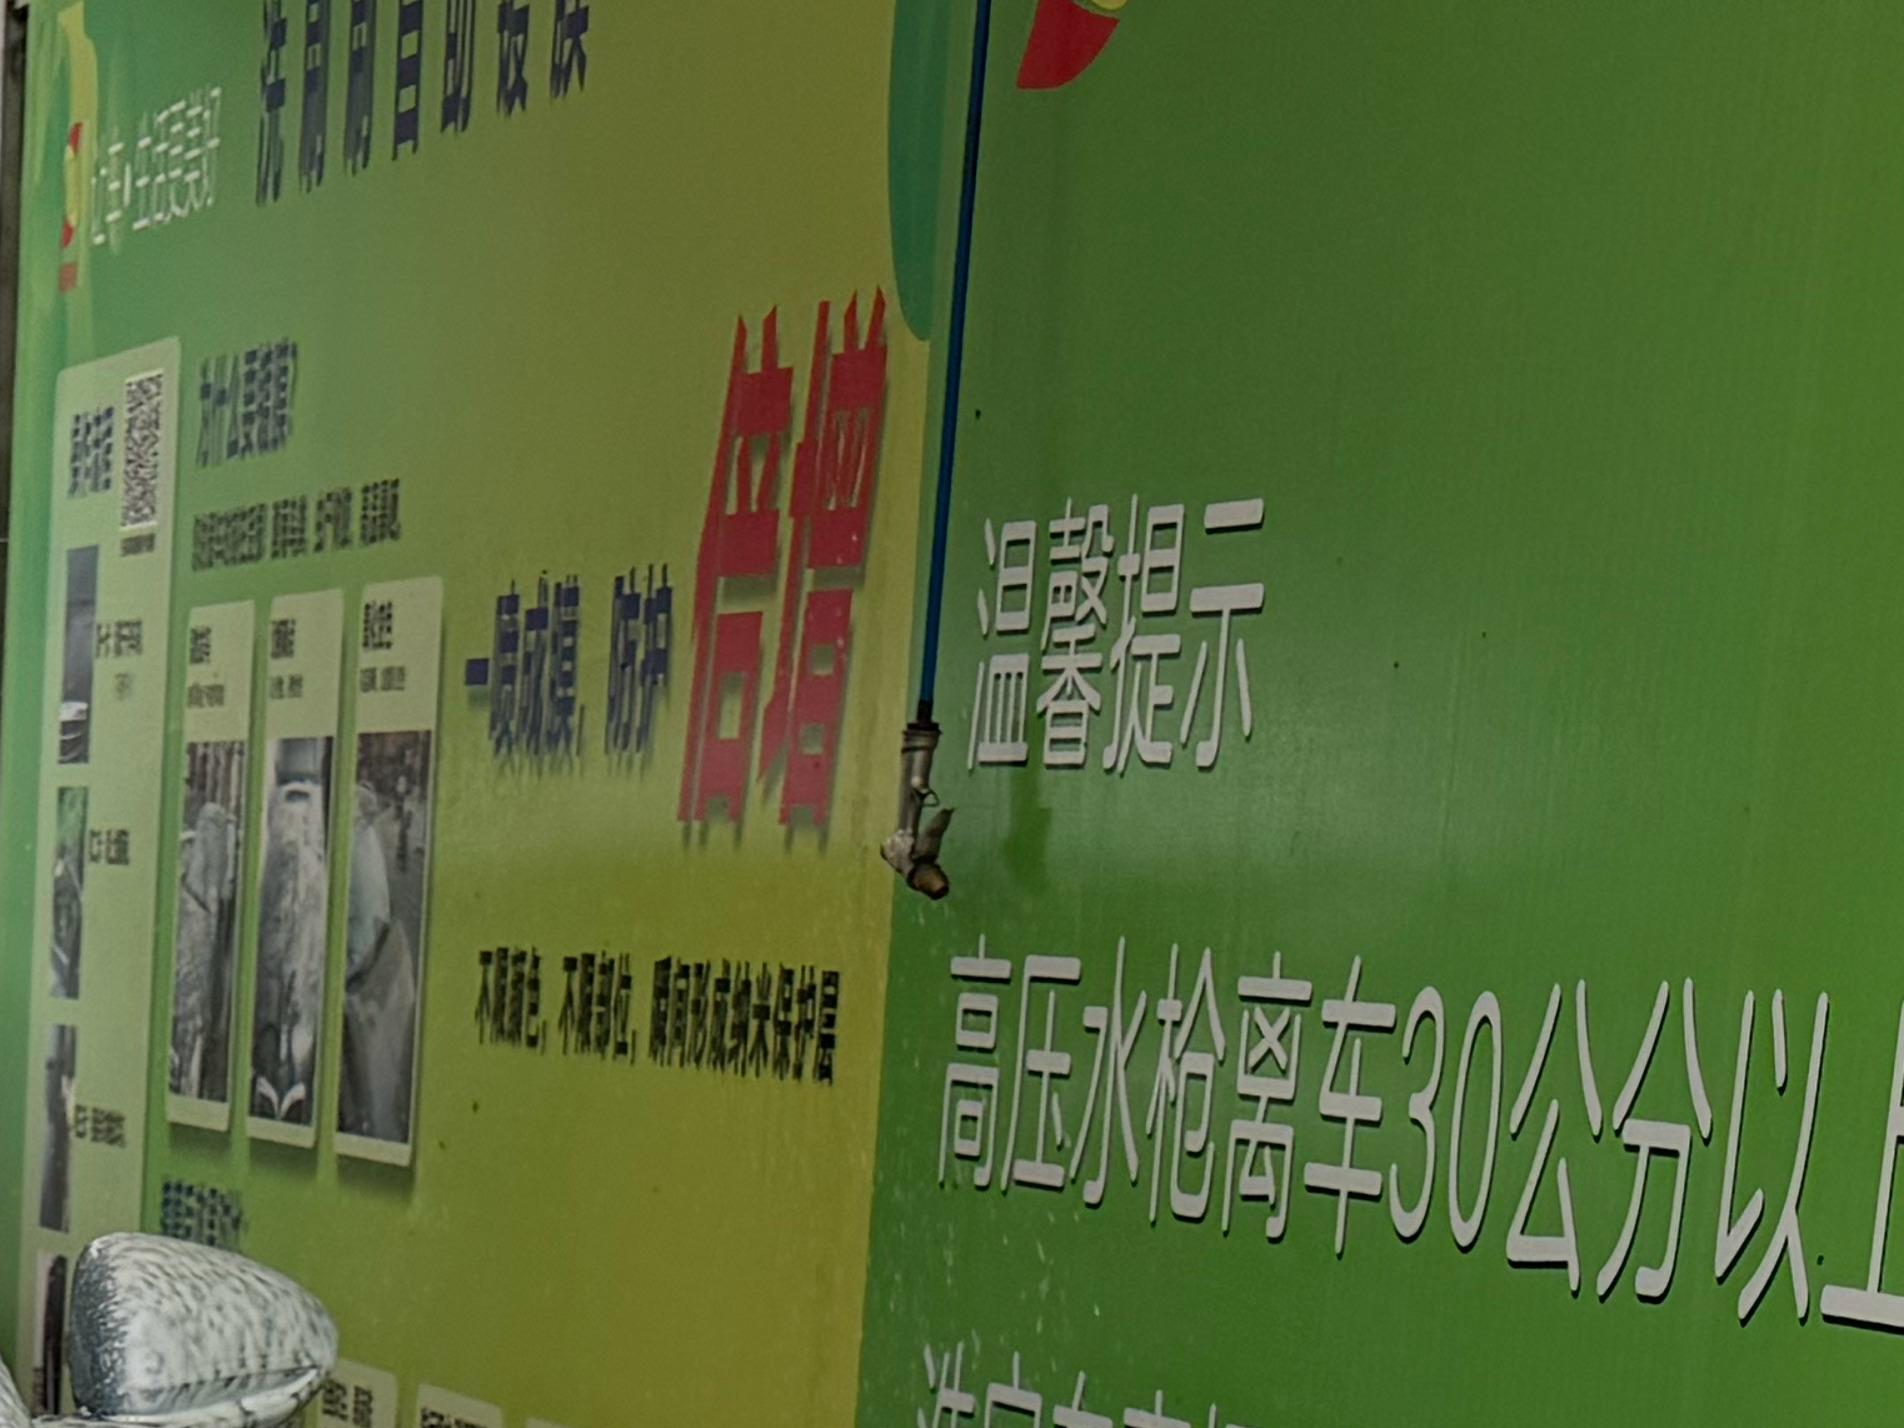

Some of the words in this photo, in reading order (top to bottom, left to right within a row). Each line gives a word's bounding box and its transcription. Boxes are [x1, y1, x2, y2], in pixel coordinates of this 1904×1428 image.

[678, 285, 887, 828] 倍增
[968, 494, 1264, 774] 温馨提示
[938, 934, 1904, 1334] 高压水枪离车30公分以上
